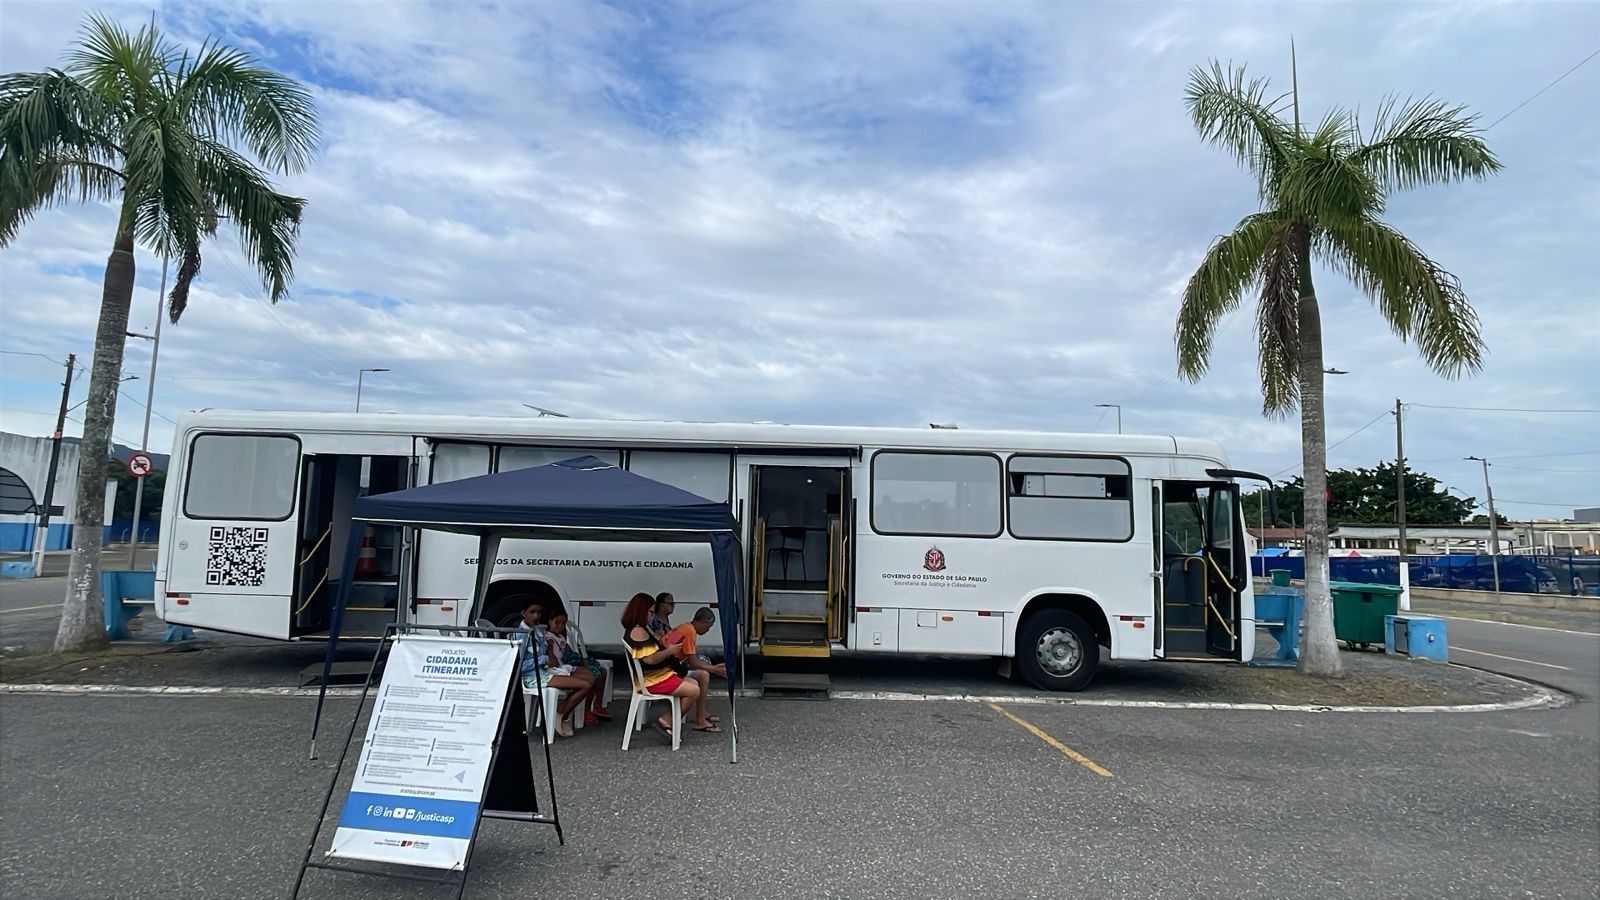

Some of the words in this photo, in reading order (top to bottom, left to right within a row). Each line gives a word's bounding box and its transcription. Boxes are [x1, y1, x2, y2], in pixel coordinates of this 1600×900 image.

[526, 558, 581, 566] SECRETARIA
[583, 559, 596, 567] DA
[598, 560, 634, 569] JUSTIÇA
[644, 561, 694, 569] CIDADANIA
[955, 574, 967, 582] SÃO
[425, 655, 478, 666] CIDADANIA
[422, 665, 478, 676] ITINERANTE
[414, 811, 455, 825] /justicasp
